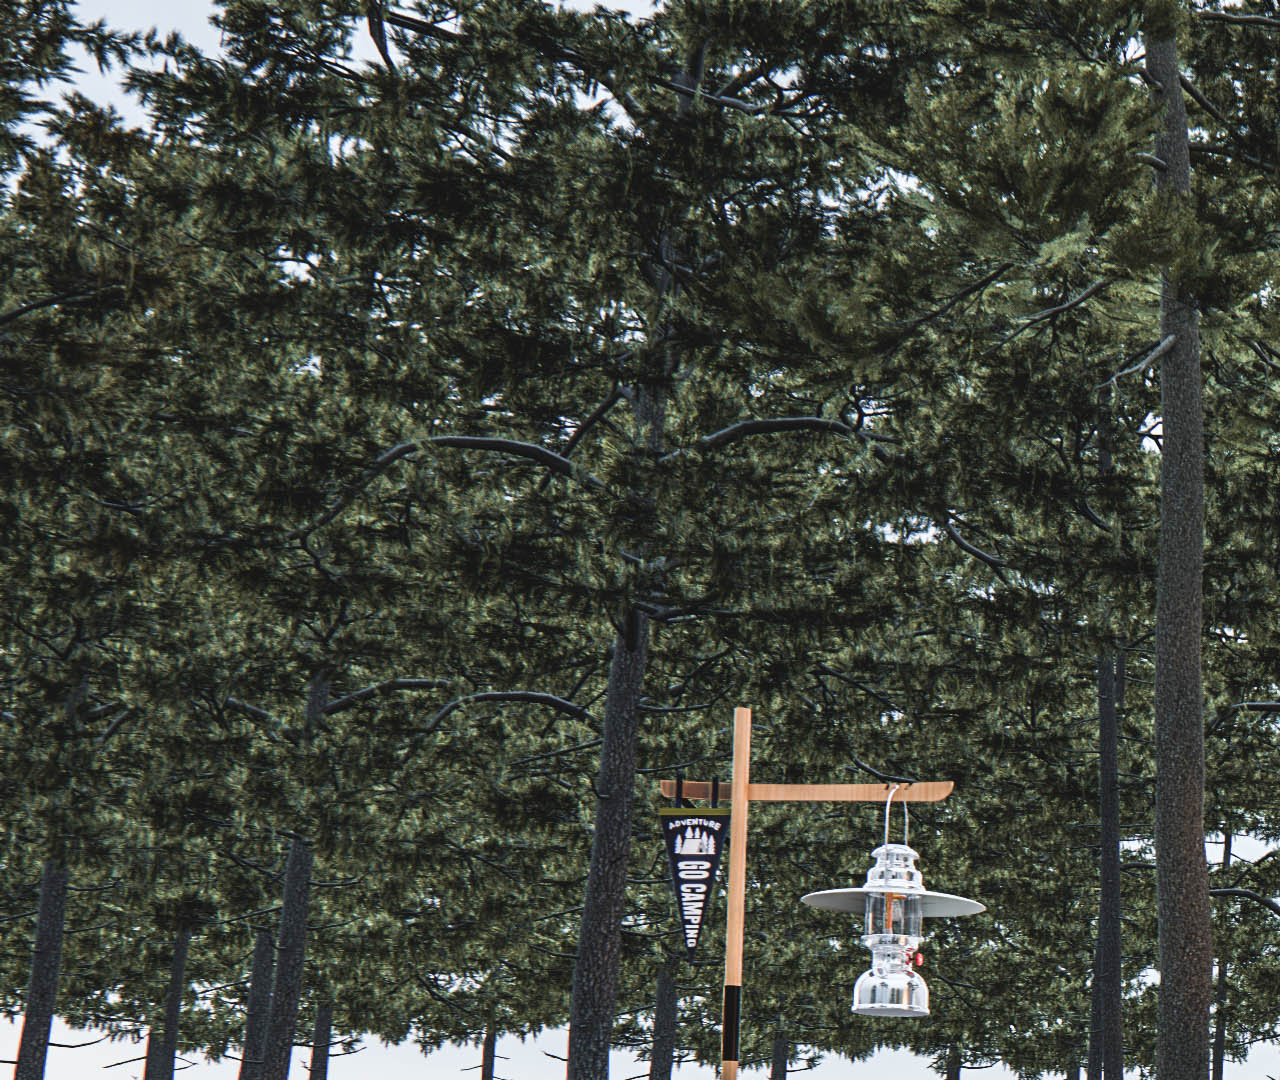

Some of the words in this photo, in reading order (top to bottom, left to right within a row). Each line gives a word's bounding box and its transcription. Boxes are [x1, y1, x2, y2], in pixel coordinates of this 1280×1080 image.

[668, 818, 722, 831] ADVENTURE
[677, 861, 712, 880] GO
[680, 883, 708, 948] CAMPING
